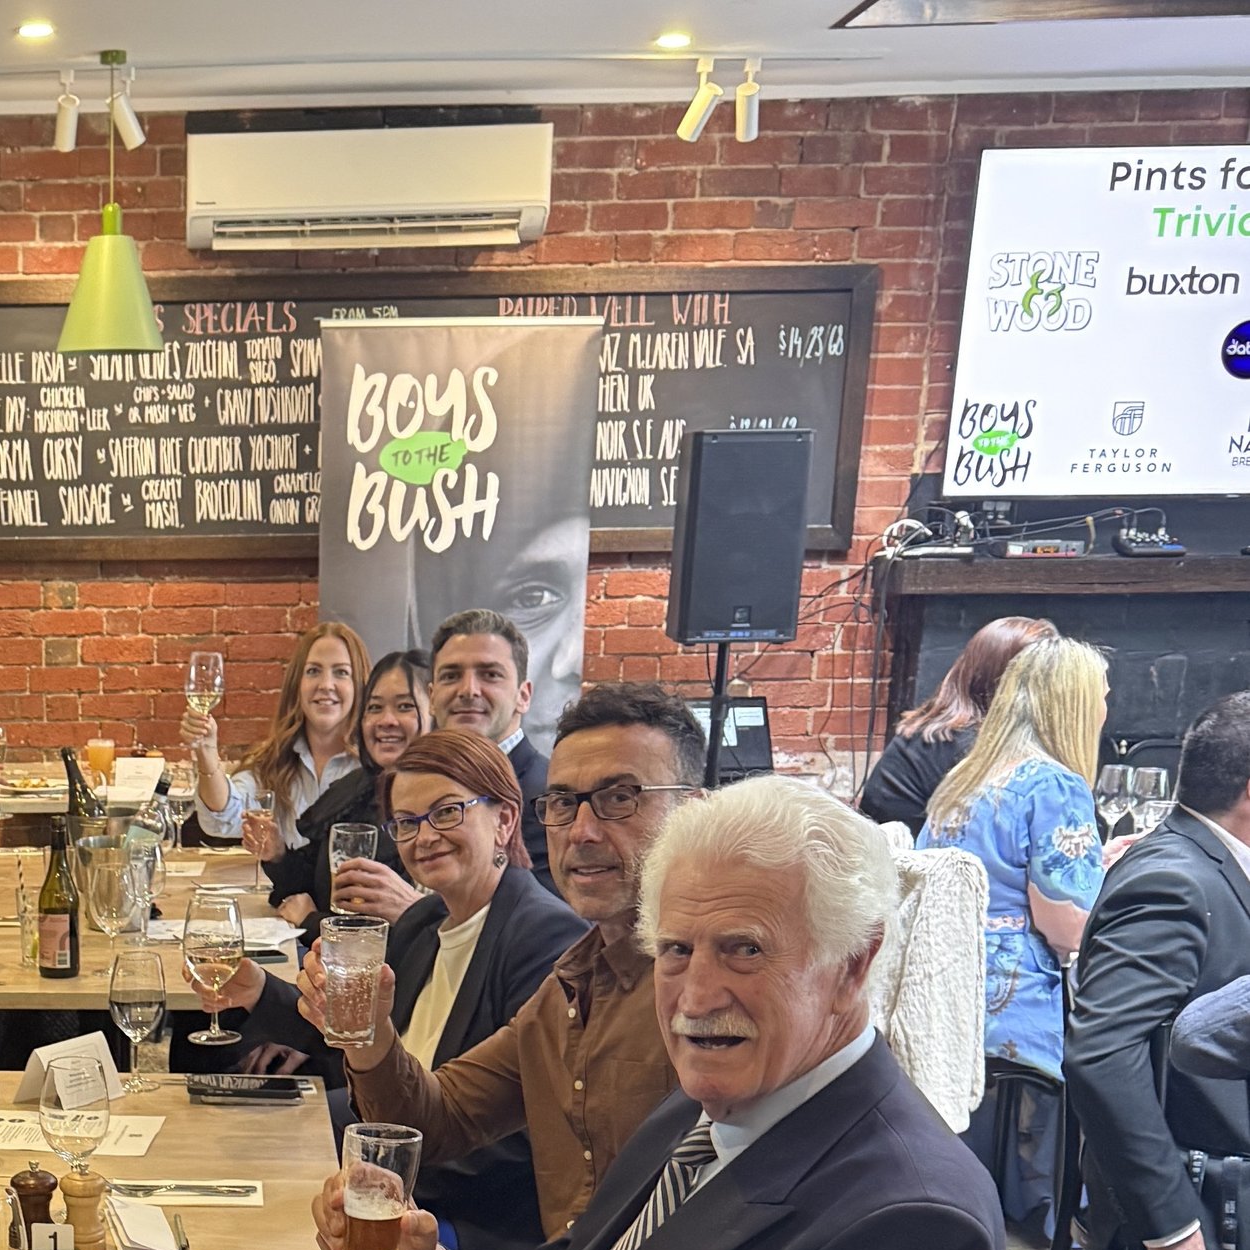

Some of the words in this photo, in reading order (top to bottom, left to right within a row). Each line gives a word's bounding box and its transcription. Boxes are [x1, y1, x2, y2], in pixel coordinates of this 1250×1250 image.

[1109, 159, 1207, 191] Pints
[989, 250, 1100, 289] STONE
[1126, 266, 1240, 296] buxton
[182, 301, 297, 335] SPECIALS
[672, 293, 731, 326] WITH
[987, 297, 1092, 332] WOOD
[244, 336, 283, 360] TOMATO
[289, 338, 323, 378] SPINA
[736, 326, 755, 365] SA
[31, 351, 65, 383] PASTA
[40, 385, 86, 409] CHICKEN
[133, 385, 160, 403] CHIPS
[166, 382, 195, 400] SALAD
[254, 382, 315, 424] MUSHROOM
[347, 363, 498, 454] BOYS
[638, 374, 655, 410] UK
[34, 409, 79, 433] MUSHROOM
[86, 407, 111, 431] LEEK
[128, 406, 142, 423] OR
[144, 404, 169, 424] MASH
[178, 403, 196, 423] VEG
[958, 398, 1037, 439] BOYS
[42, 435, 83, 480] CURRY
[109, 436, 156, 478] SAFFRON
[188, 436, 243, 474] CUCUMBER
[249, 433, 300, 471] YOGHURT
[415, 443, 452, 466] THE
[596, 420, 628, 461] NOIR
[1089, 448, 1158, 459] TAYLOR
[953, 446, 1031, 488] BUSH
[1070, 462, 1172, 473] FERGUSON
[58, 483, 116, 526] SAUSAGE
[141, 477, 182, 501] CREAMY
[269, 498, 299, 524] ONION
[347, 462, 500, 553] BUSH
